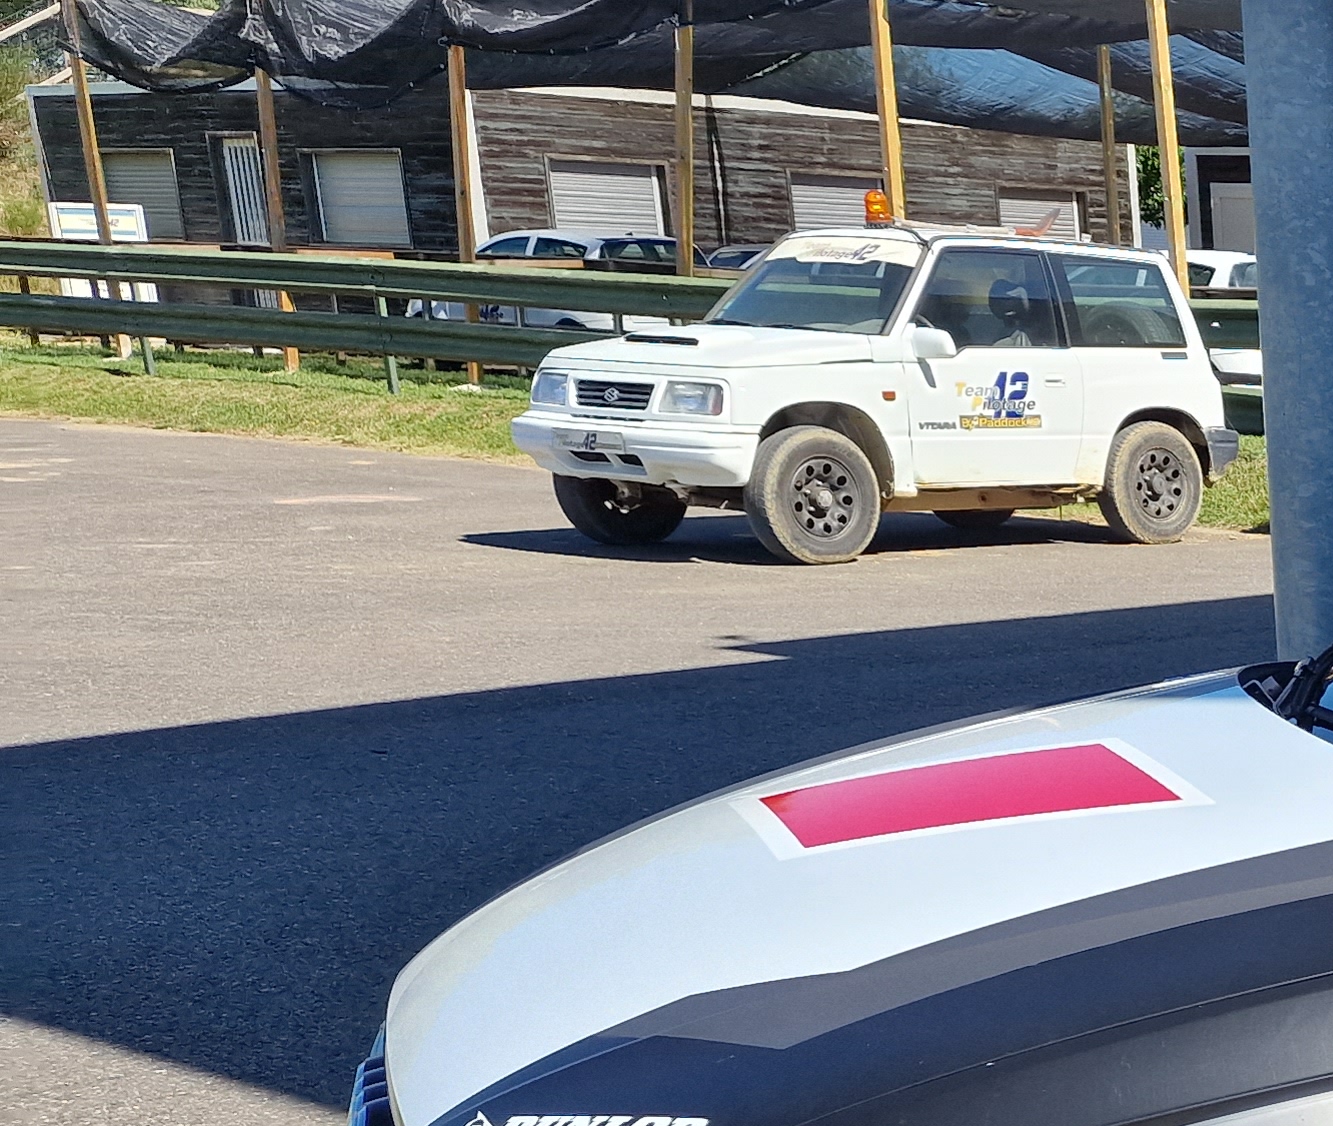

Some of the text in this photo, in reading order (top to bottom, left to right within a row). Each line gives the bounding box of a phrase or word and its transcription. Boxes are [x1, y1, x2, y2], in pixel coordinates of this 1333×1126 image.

[955, 382, 998, 398] Team
[993, 371, 1029, 419] 42
[971, 396, 1037, 414] Pilotage
[582, 432, 598, 451] 42
